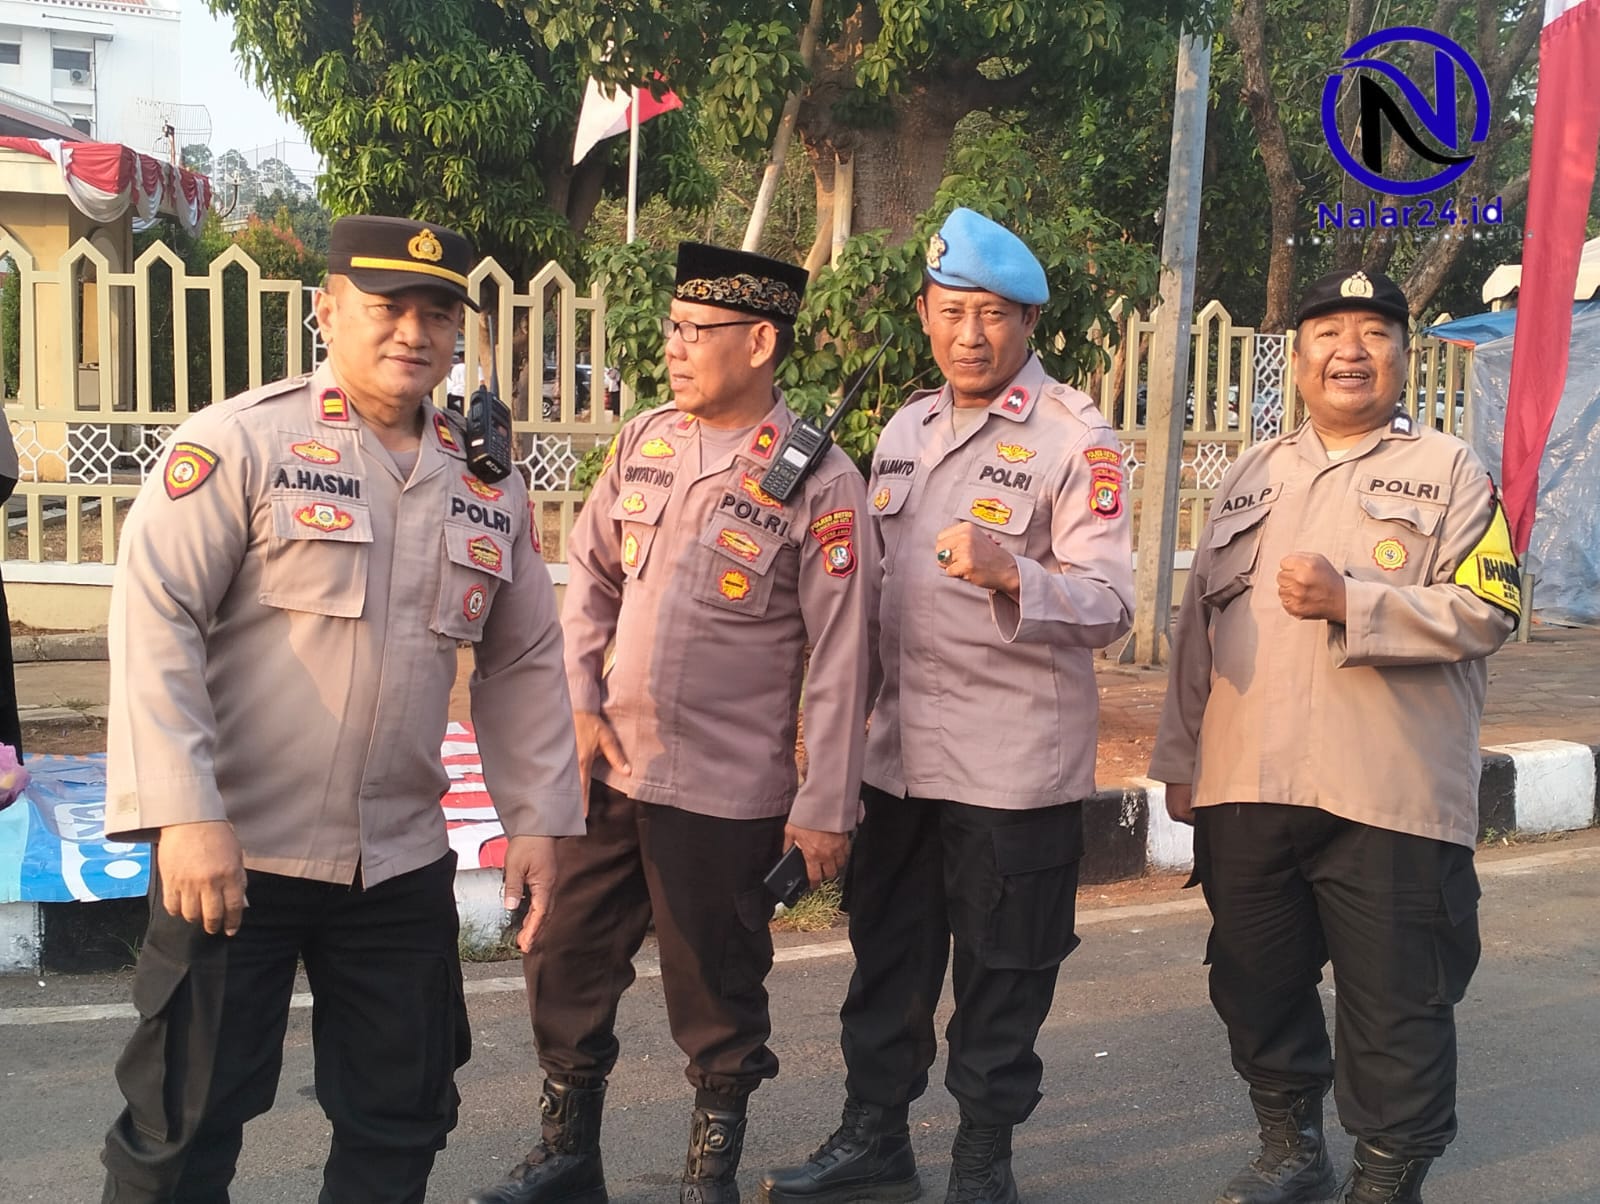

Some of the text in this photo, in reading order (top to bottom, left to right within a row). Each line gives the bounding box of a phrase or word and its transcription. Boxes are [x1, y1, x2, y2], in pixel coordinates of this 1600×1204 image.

[273, 467, 361, 500] A.HASMI
[979, 464, 1032, 491] POLRI
[1369, 478, 1440, 501] POLRI
[1259, 487, 1273, 502] P
[450, 496, 511, 535] POLRI
[719, 491, 789, 538] POLRI
